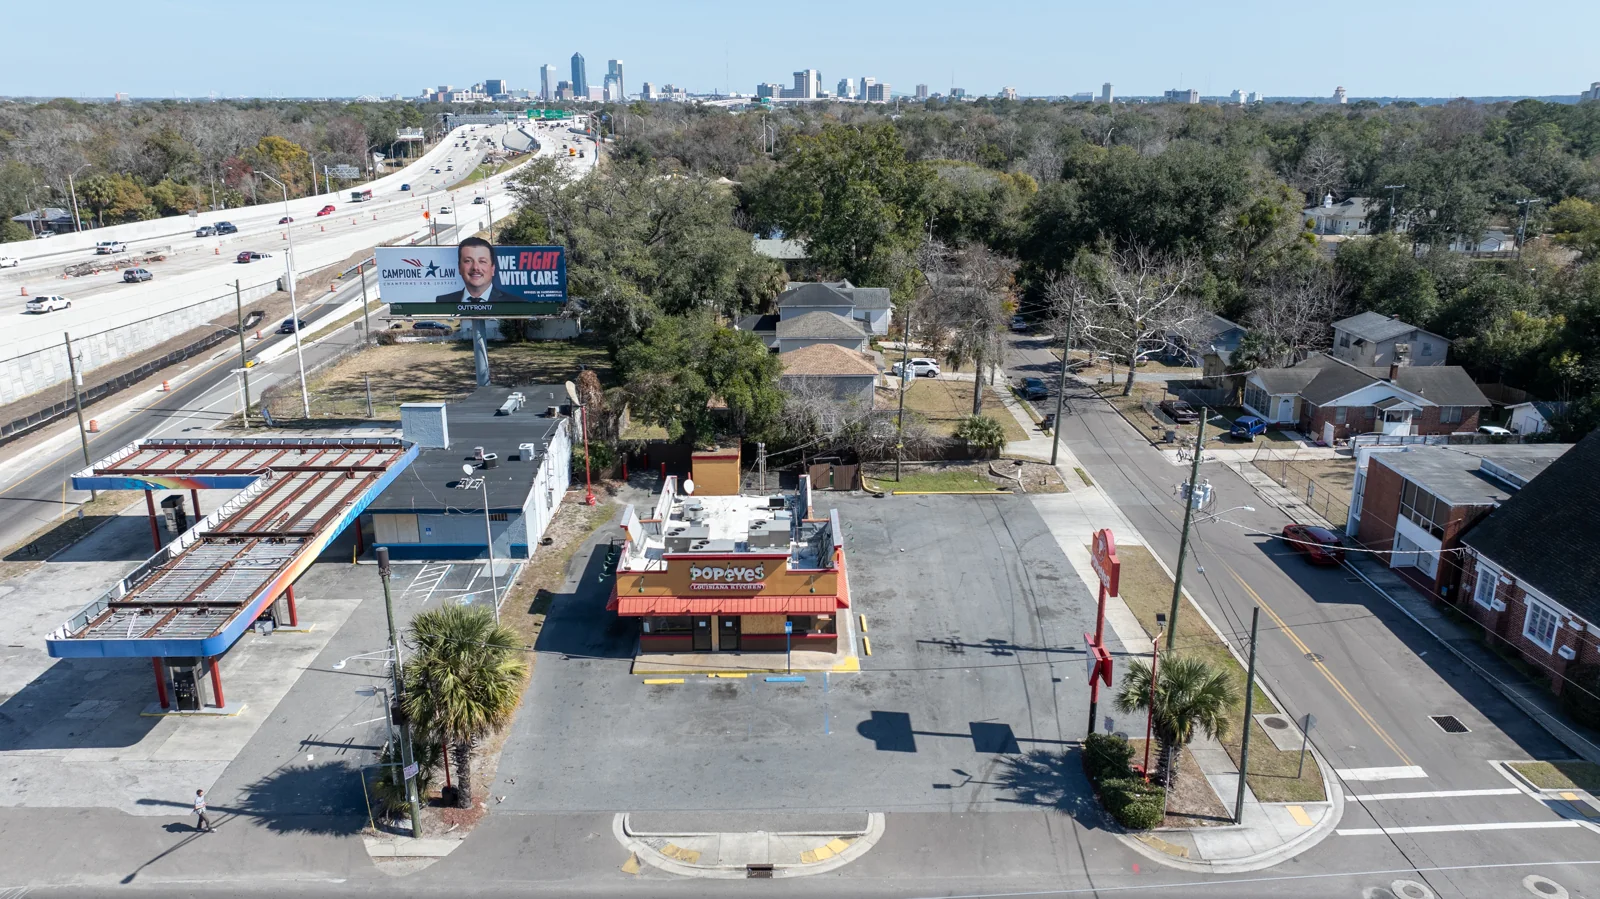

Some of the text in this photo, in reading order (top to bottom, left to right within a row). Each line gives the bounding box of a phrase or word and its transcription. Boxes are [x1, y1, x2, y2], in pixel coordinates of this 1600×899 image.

[497, 251, 560, 270] WE FIGHT
[382, 268, 456, 279] CAMPIONE LAW
[499, 271, 559, 286] WITH CARE
